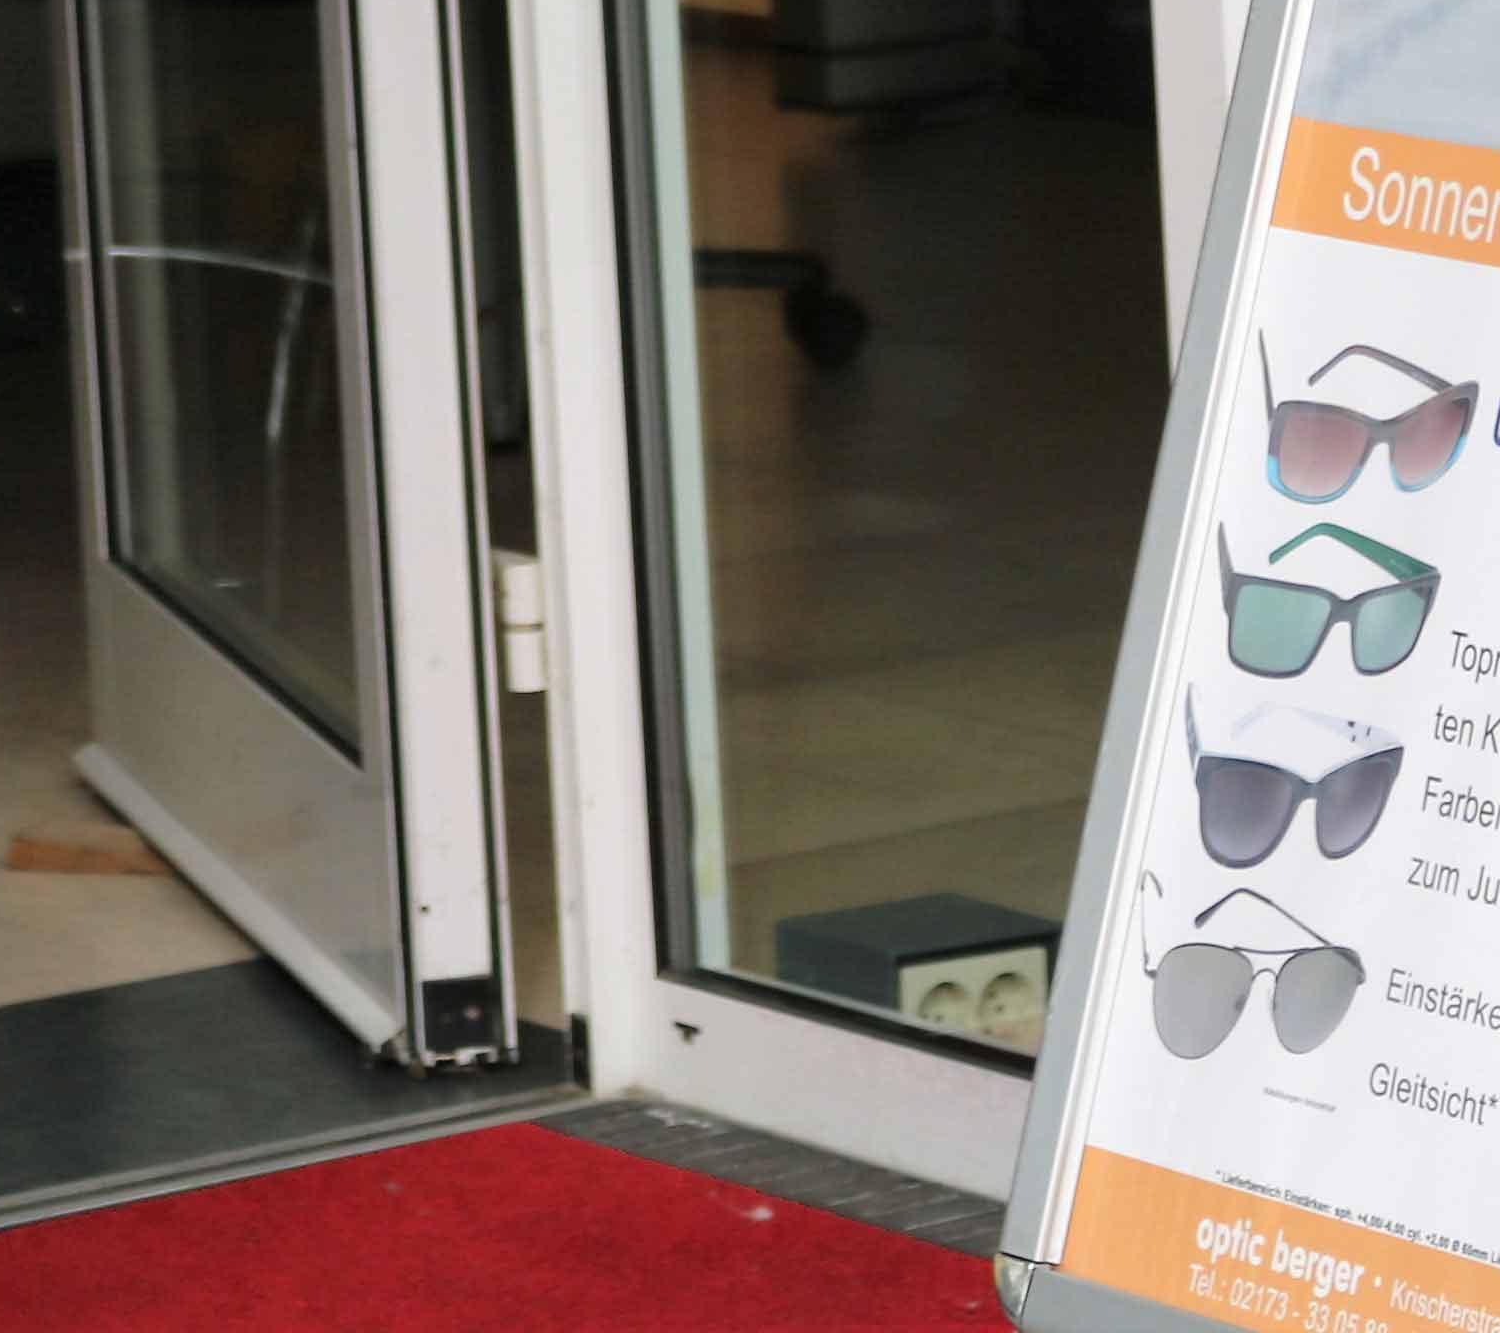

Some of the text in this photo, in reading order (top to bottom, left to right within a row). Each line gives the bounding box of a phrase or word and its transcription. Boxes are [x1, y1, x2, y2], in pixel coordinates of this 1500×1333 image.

[1434, 704, 1475, 748] ten
[1408, 857, 1460, 895] zum
[1195, 1217, 1266, 1266] optic
[1271, 1229, 1365, 1298] berger
[1188, 1263, 1227, 1302] Tel.:
[1229, 1276, 1290, 1322] 02173
[1304, 1300, 1330, 1333] 33
[1332, 1309, 1360, 1333] 05
